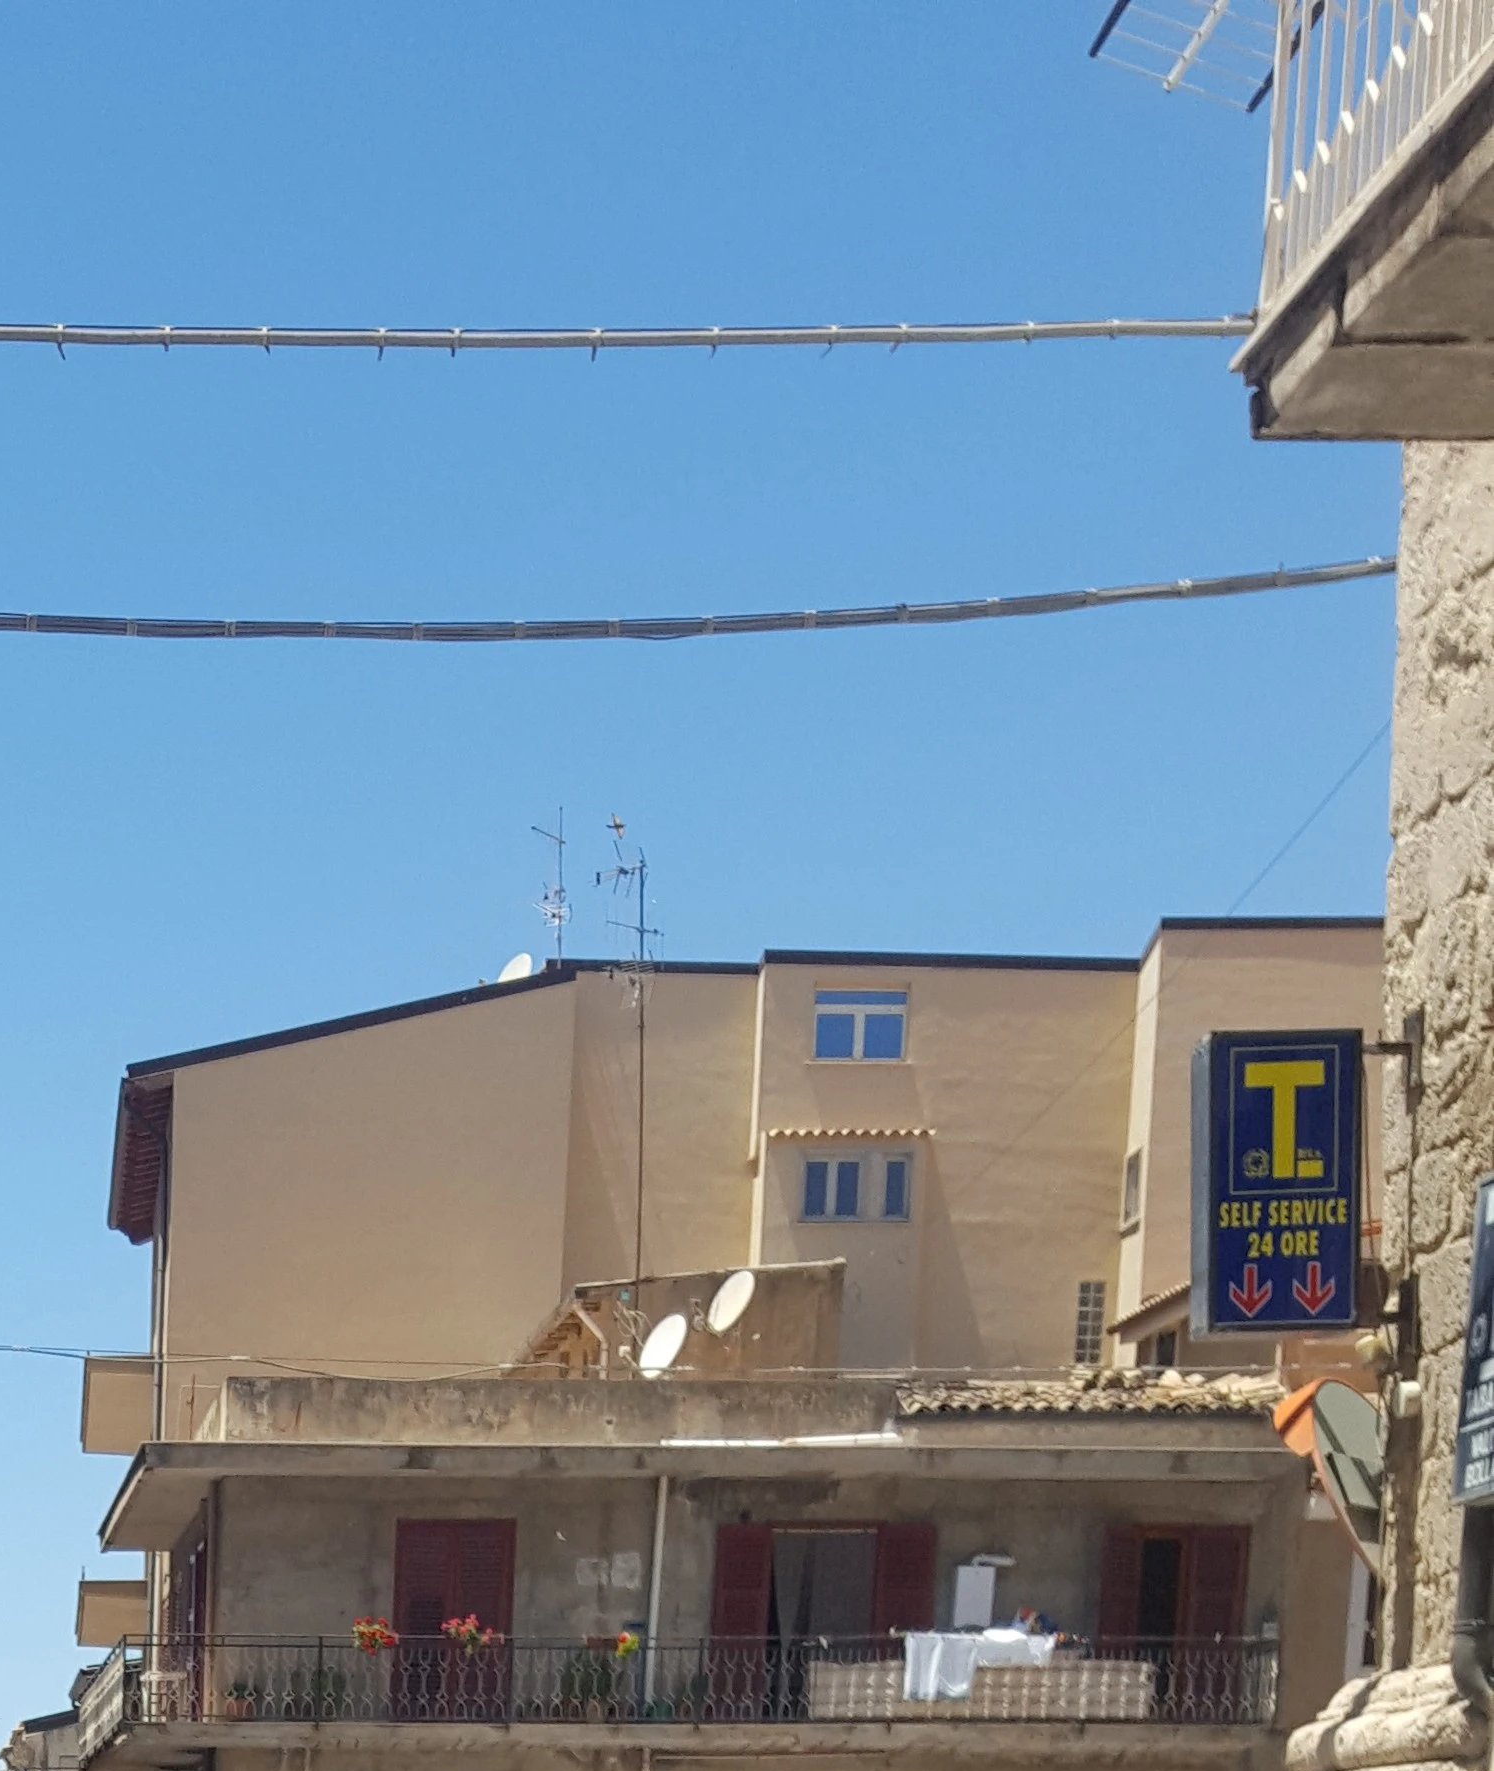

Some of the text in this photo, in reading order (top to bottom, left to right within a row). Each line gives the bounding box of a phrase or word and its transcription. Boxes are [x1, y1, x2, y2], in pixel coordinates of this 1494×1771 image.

[1219, 1198, 1348, 1228] SELF SERVICE
[1247, 1231, 1320, 1258] 24 ORE
